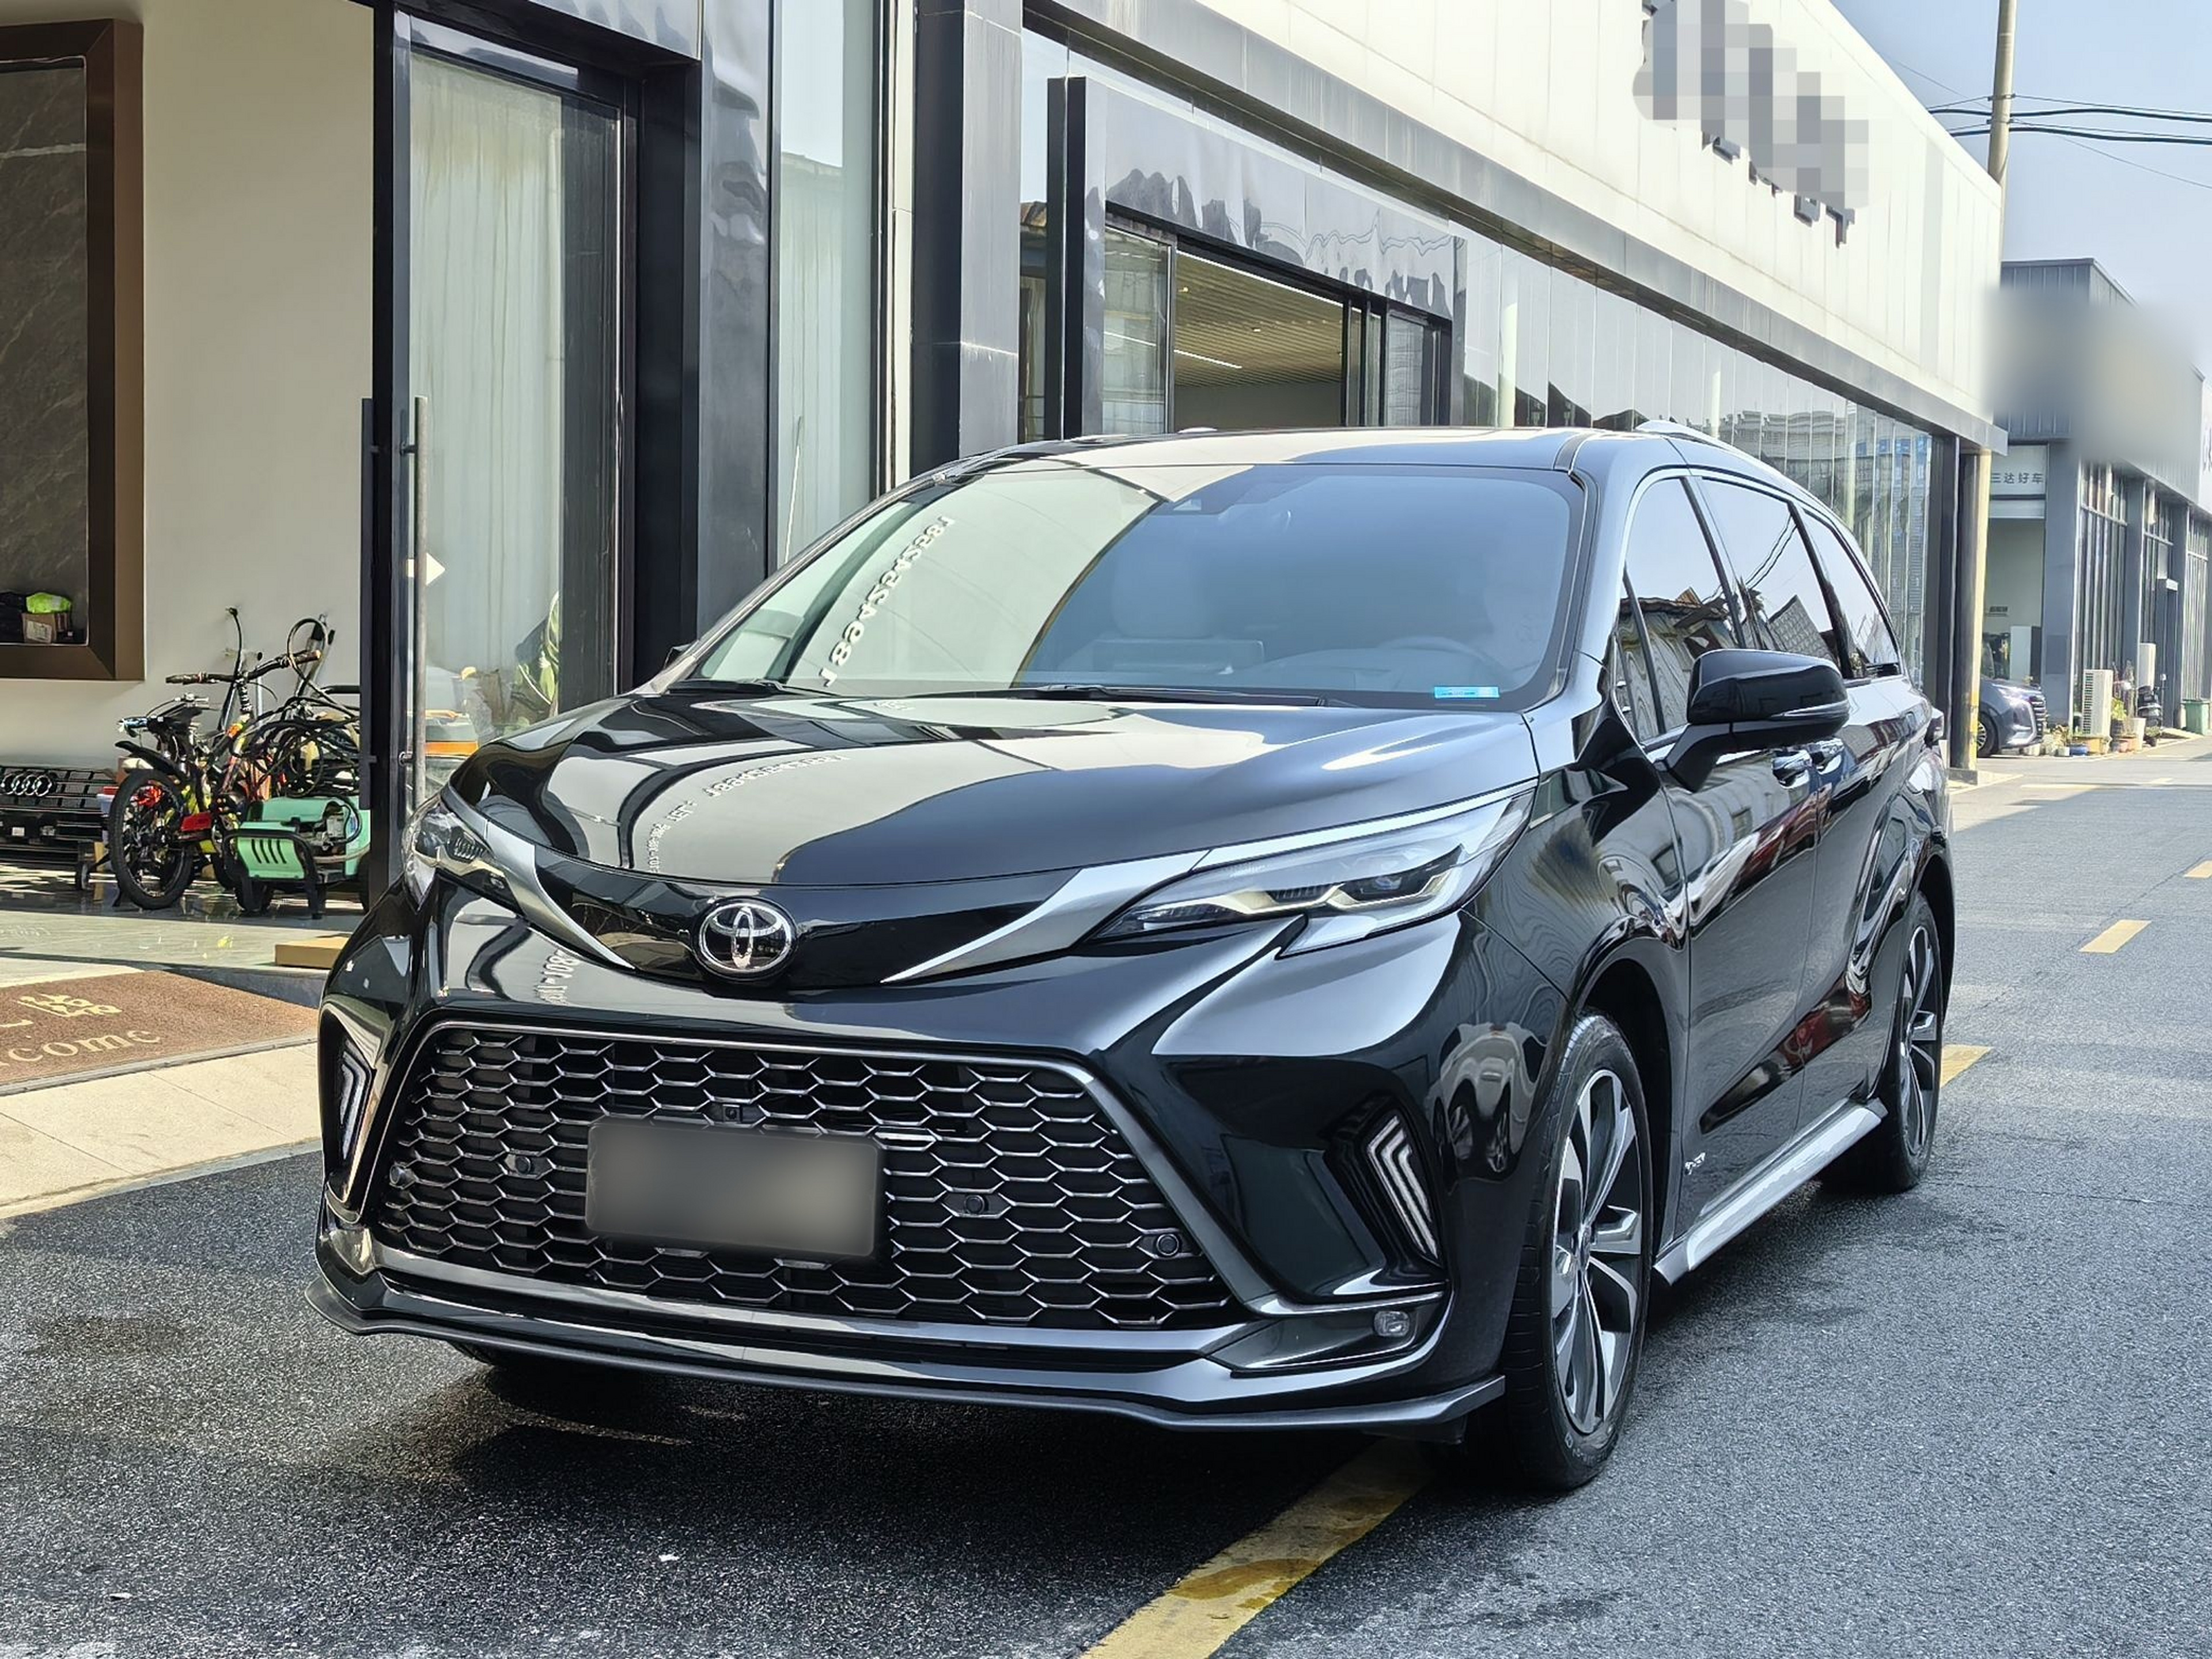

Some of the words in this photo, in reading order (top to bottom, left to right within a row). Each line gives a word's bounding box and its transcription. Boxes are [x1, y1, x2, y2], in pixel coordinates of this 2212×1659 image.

[1990, 472, 2044, 484] 三达好车
[0, 1029, 161, 1066] come
